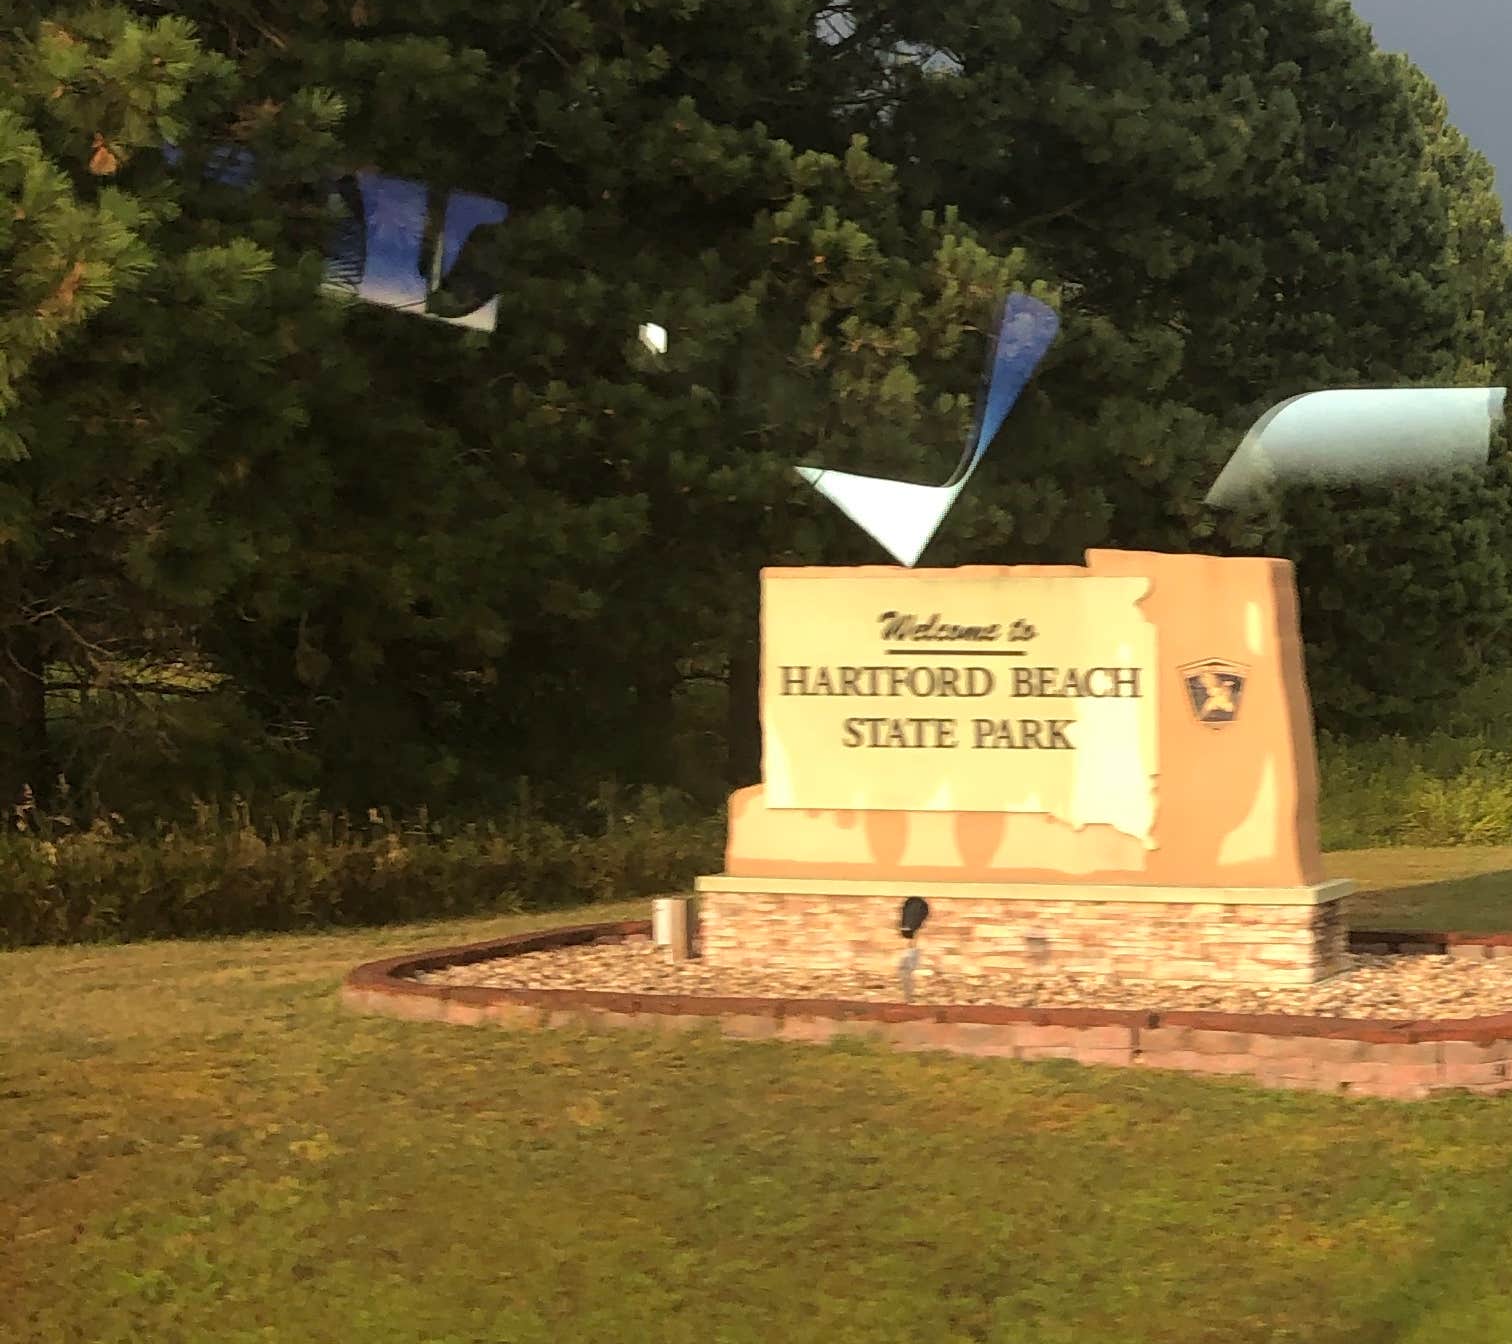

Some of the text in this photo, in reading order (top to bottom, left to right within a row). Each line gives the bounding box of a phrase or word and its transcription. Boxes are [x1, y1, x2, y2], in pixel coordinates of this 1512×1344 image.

[878, 610, 1039, 641] Welcome to
[779, 666, 1143, 698] HARTFORD BEACH
[842, 717, 1077, 749] STATE PARK
